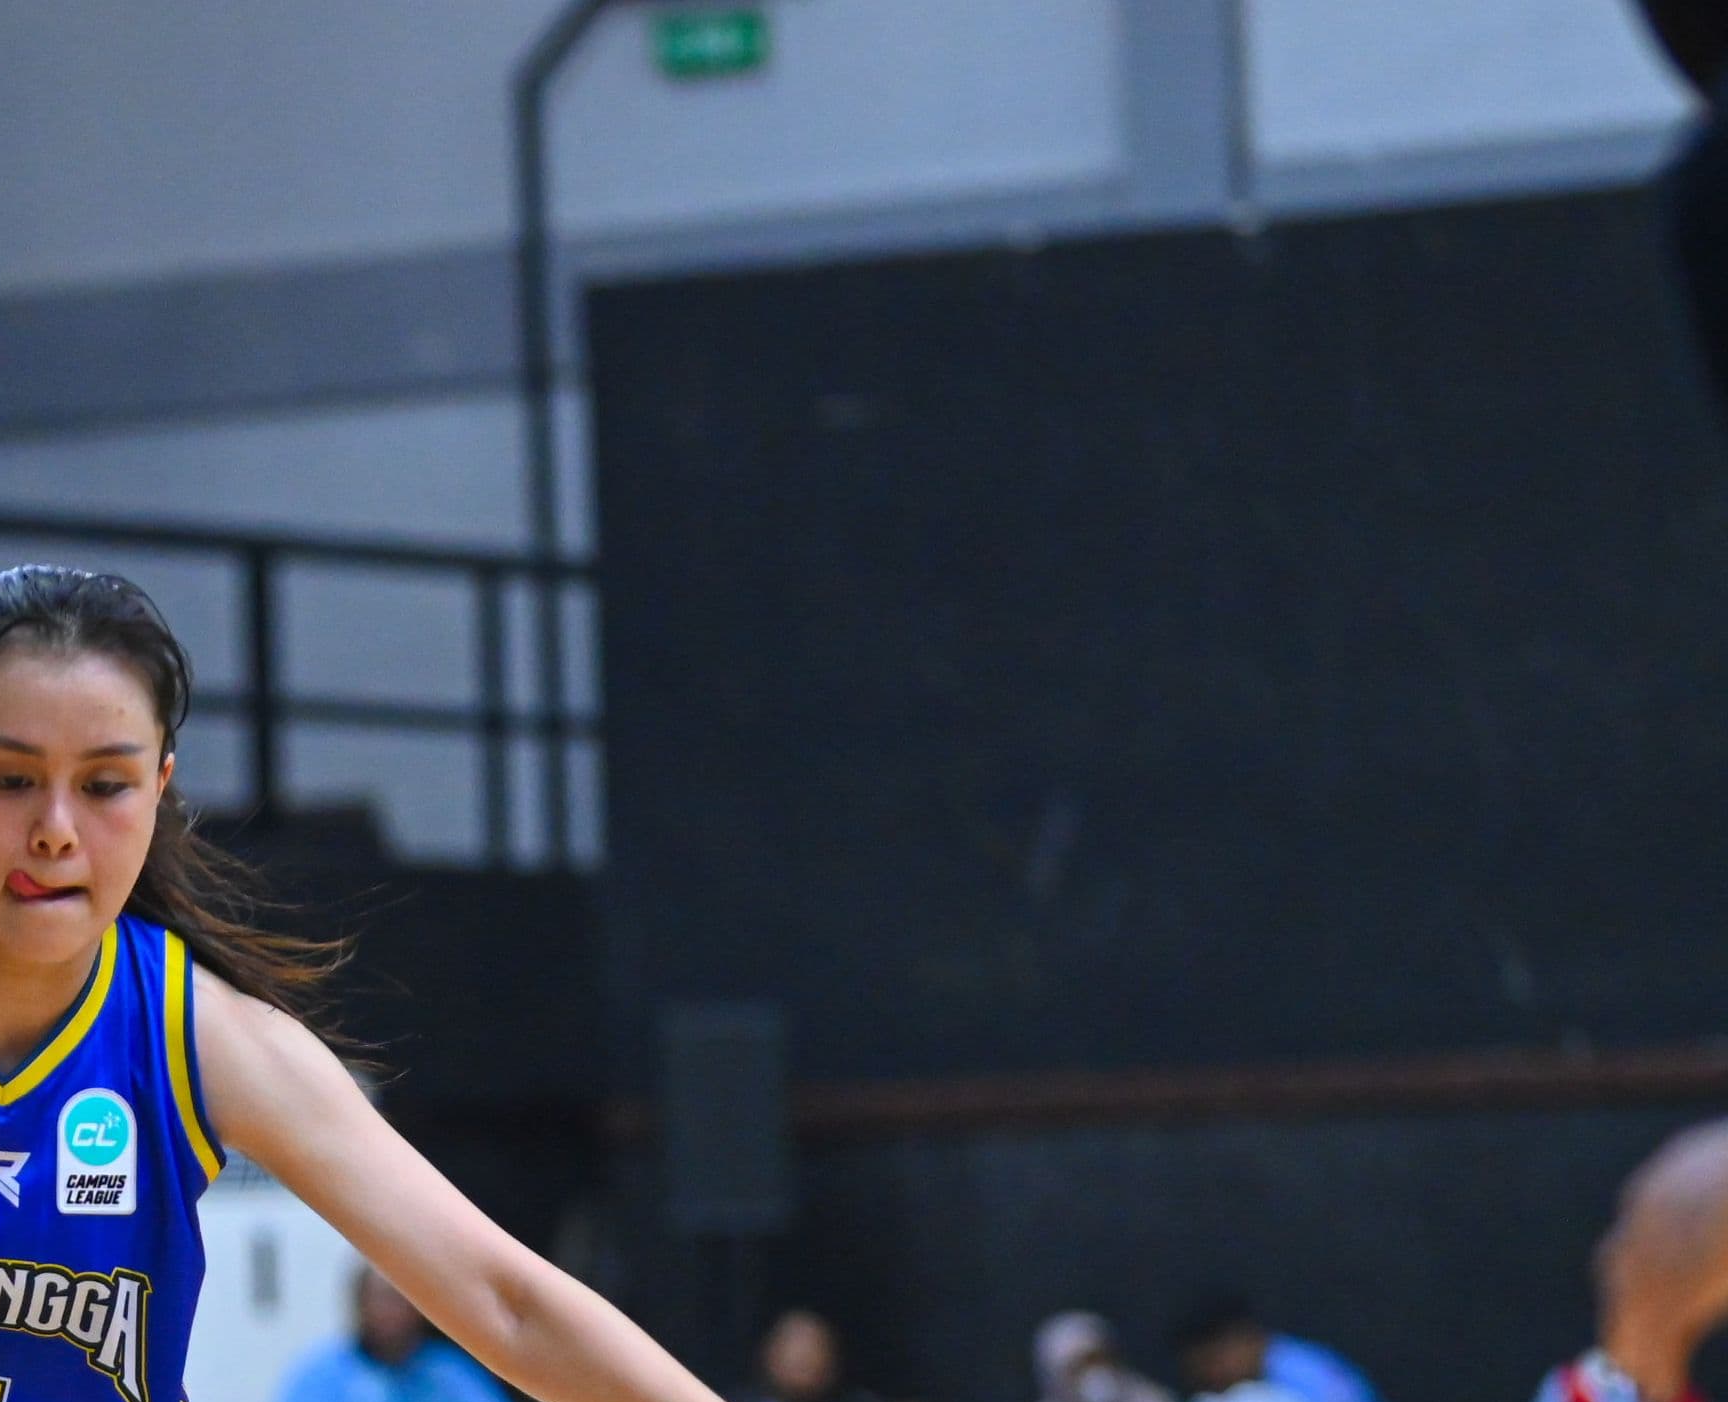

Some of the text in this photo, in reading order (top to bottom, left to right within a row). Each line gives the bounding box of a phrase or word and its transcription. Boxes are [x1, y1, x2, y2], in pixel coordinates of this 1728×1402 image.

[72, 1122, 118, 1147] CL
[66, 1174, 127, 1189] CAMPUS
[66, 1190, 123, 1205] LEAGUE
